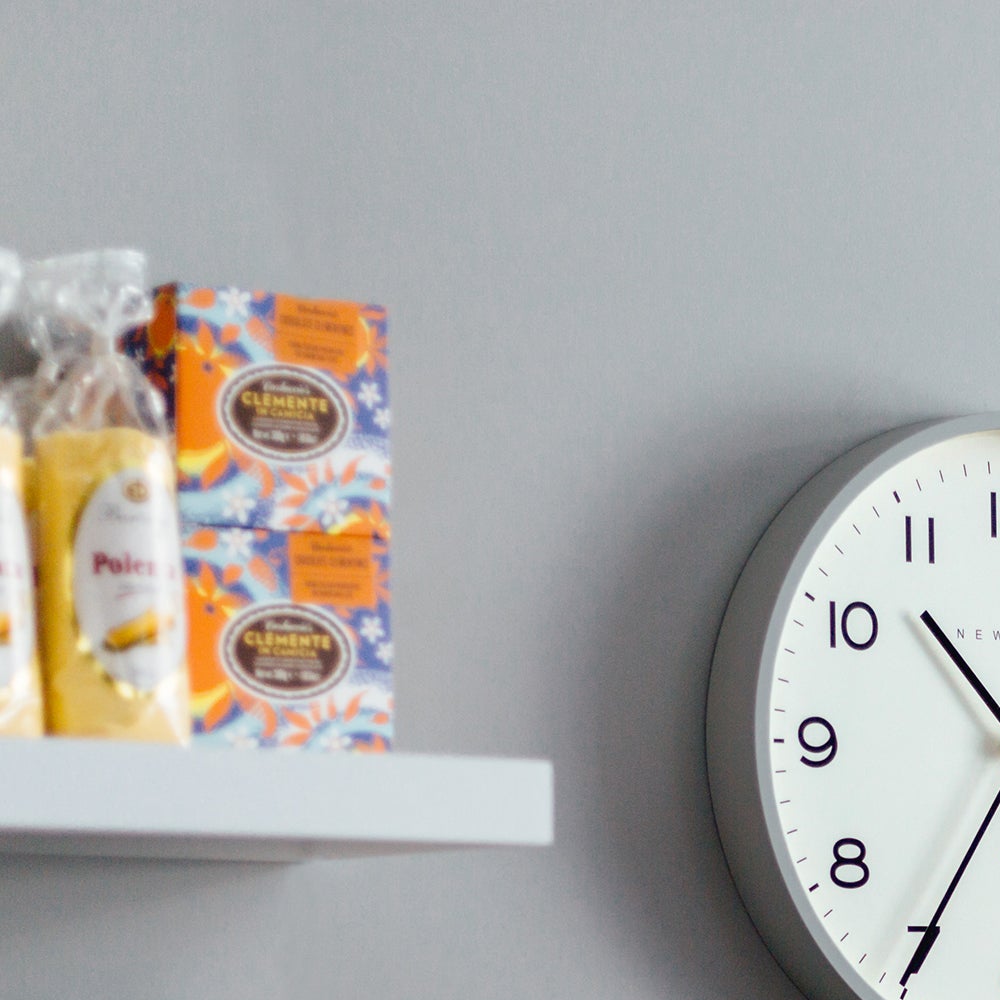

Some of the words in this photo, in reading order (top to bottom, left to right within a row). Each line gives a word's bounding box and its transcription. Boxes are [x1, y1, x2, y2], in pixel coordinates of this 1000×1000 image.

[242, 391, 328, 413] CLEMENTE
[905, 516, 935, 564] 11
[92, 552, 178, 580] Polen
[244, 631, 330, 650] CLEMENTE
[829, 601, 878, 650] 10
[798, 717, 837, 767] 9
[829, 838, 870, 889] 8
